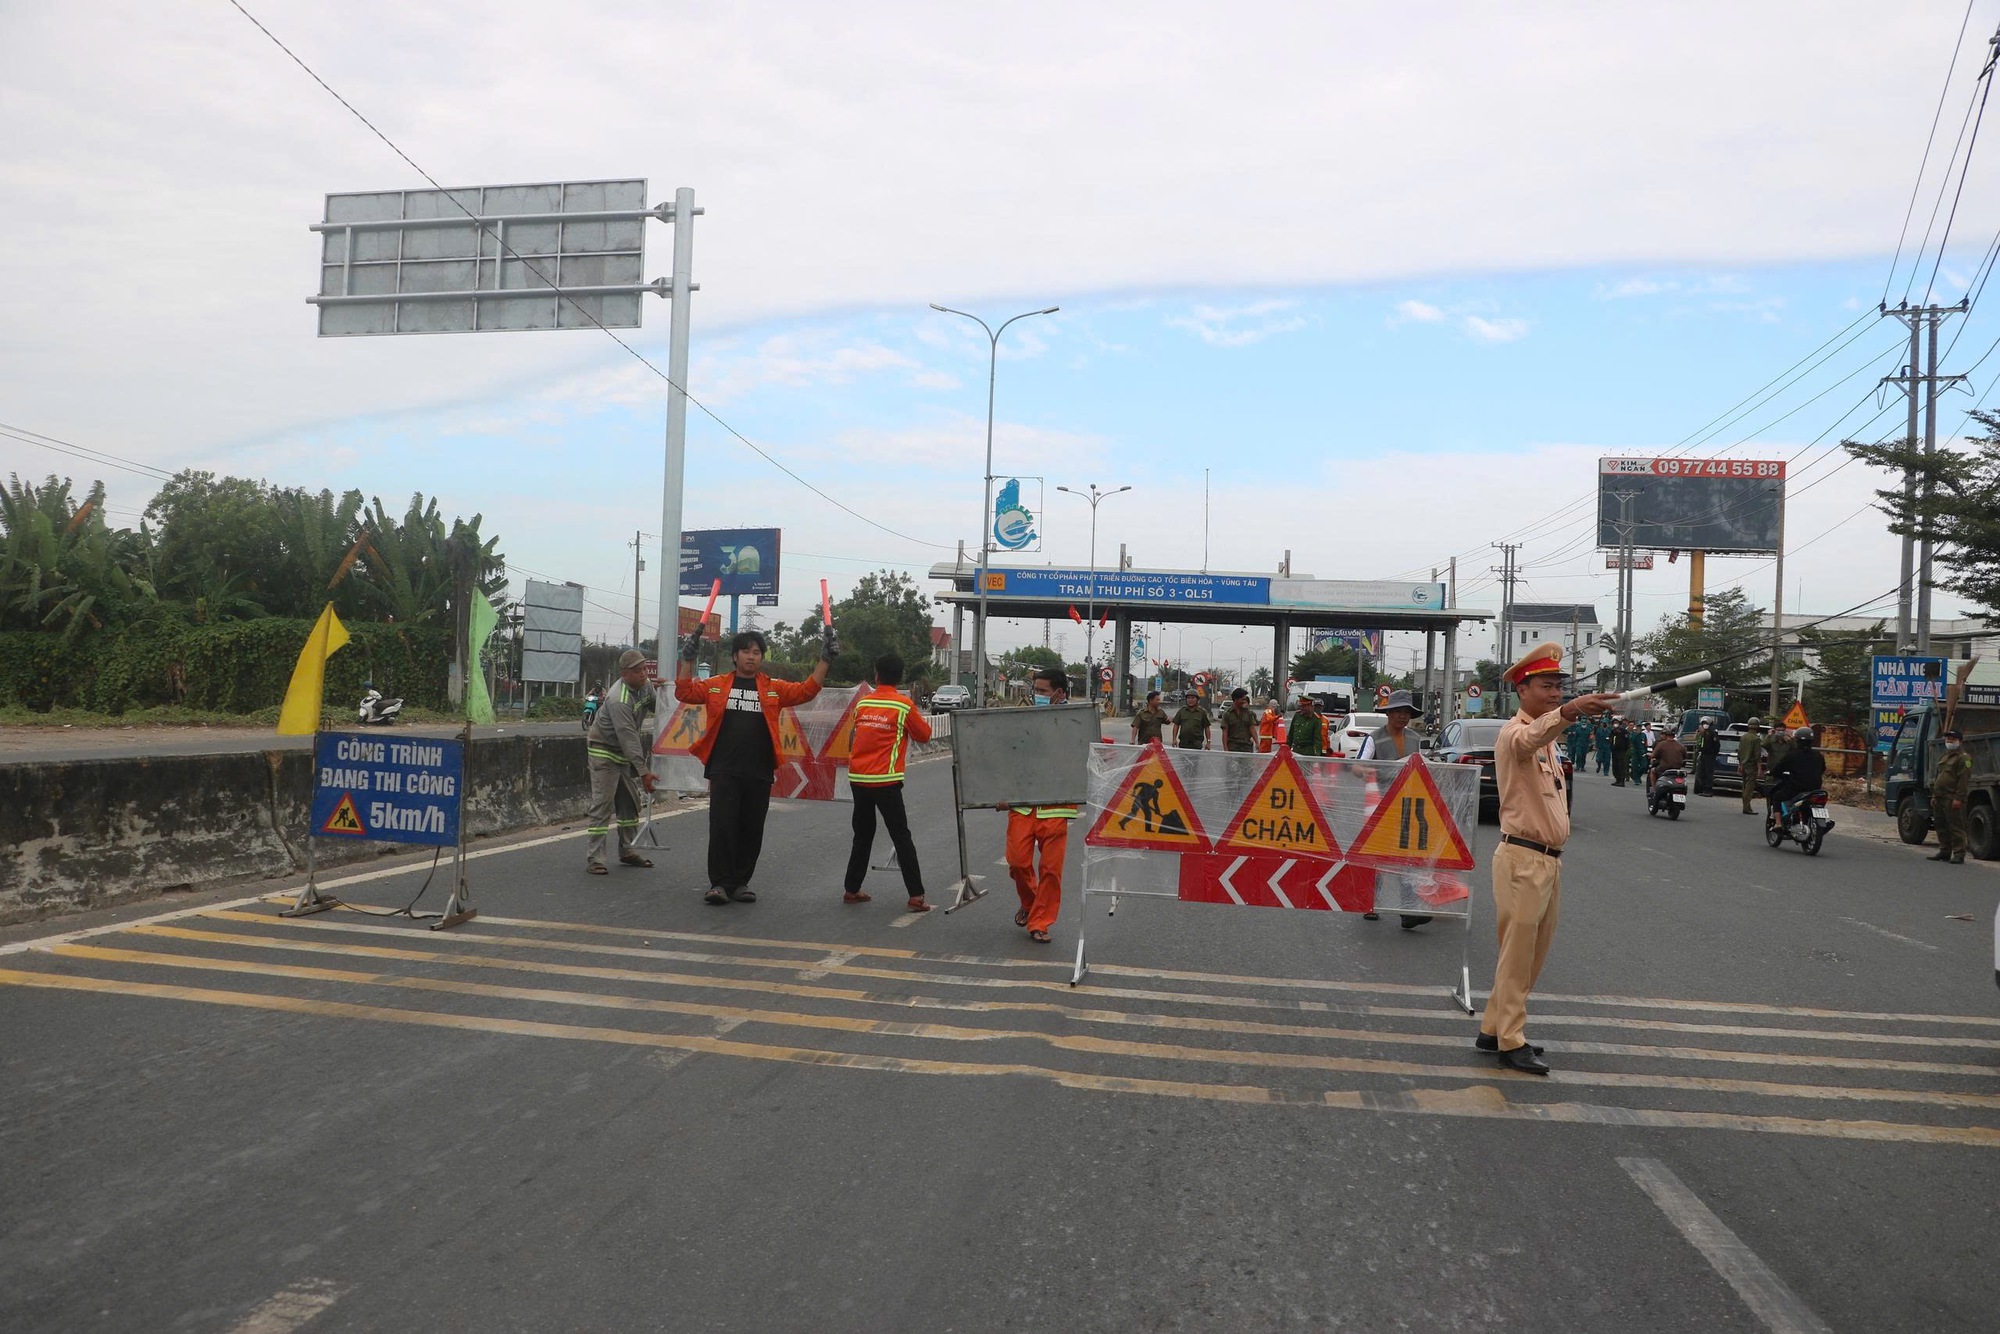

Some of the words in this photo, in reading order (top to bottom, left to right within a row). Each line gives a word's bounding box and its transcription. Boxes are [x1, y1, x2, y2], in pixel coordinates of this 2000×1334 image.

[1658, 460, 1680, 474] 09
[1683, 461, 1704, 474] 77
[1706, 462, 1728, 474] 44
[1732, 462, 1753, 475] 55
[1757, 462, 1779, 476] 88
[1016, 571, 1037, 579] CÔNG
[1164, 575, 1179, 584] TỐC
[1181, 576, 1197, 584] BIÊN
[1059, 584, 1092, 597] TRẠM
[1097, 586, 1121, 596] THU
[1124, 584, 1144, 596] PHÍ
[1148, 584, 1164, 597] SỐ
[1169, 589, 1176, 598] 3
[1185, 589, 1213, 599] QL51
[1878, 660, 1906, 676] NHÀ
[1876, 677, 1908, 696] TÂN
[726, 699, 738, 710] ORE
[337, 738, 385, 763] CÔNG
[390, 742, 442, 767] TRÌNH
[321, 768, 369, 790] ĐANG
[374, 771, 401, 792] THI
[406, 770, 455, 797] CÔNG
[1270, 788, 1294, 810] ĐI
[370, 802, 445, 833] 5km/h
[1242, 815, 1315, 848] CHẬM
